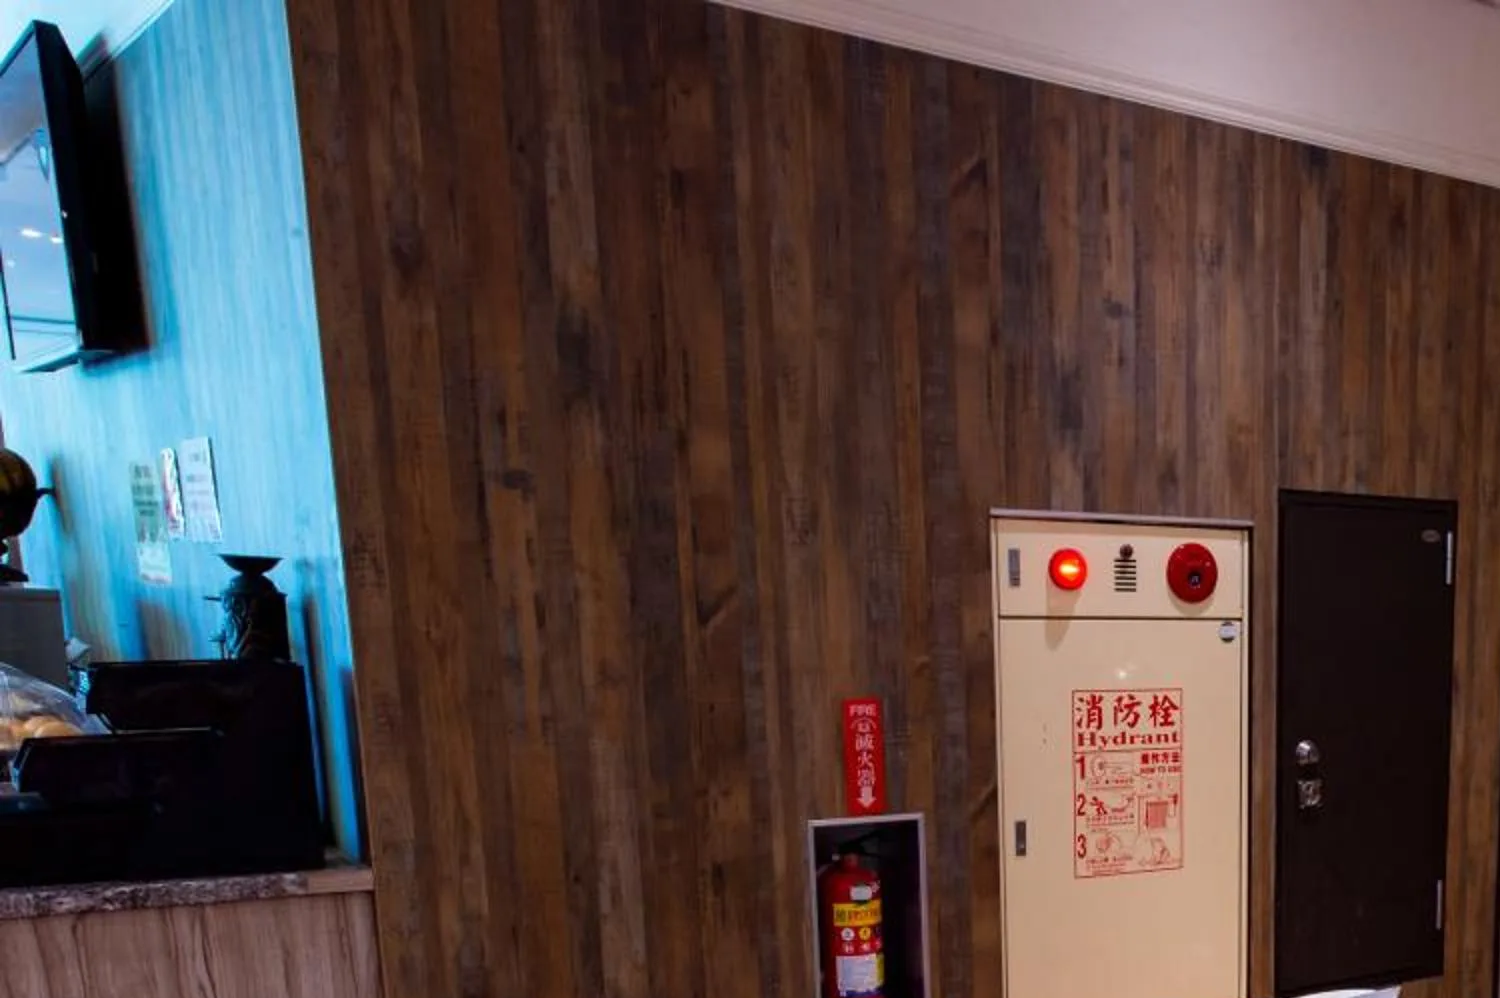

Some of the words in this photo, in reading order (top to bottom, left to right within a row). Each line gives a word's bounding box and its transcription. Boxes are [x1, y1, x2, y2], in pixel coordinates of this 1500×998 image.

[1075, 694, 1179, 731] 消防栓
[1077, 731, 1179, 748] Hydrant
[1075, 754, 1086, 780] 1
[1076, 793, 1087, 817] 2
[1076, 833, 1087, 859] 3
